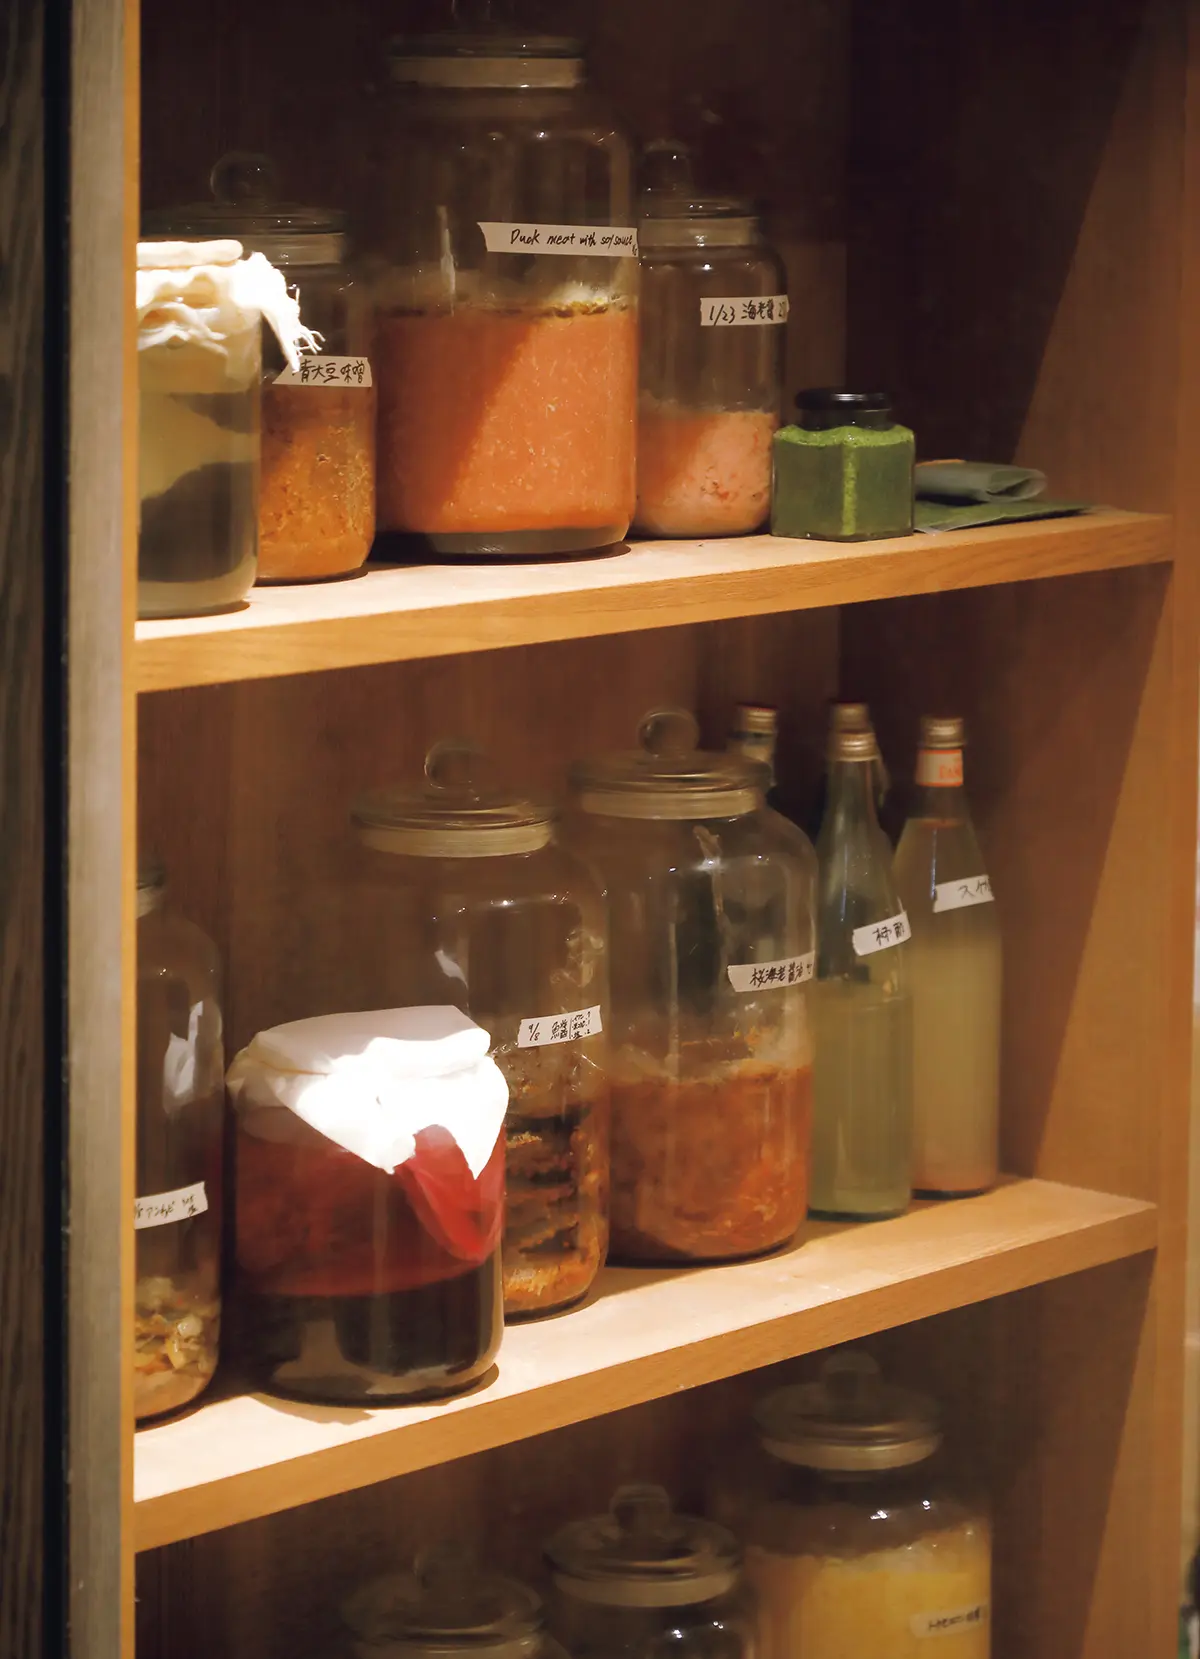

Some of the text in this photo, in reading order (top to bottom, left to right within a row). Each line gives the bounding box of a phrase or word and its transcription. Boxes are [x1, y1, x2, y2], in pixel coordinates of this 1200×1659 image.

[510, 228, 540, 245] Duck
[546, 233, 576, 246] meat
[579, 231, 597, 247] with
[709, 303, 736, 326] 1/23
